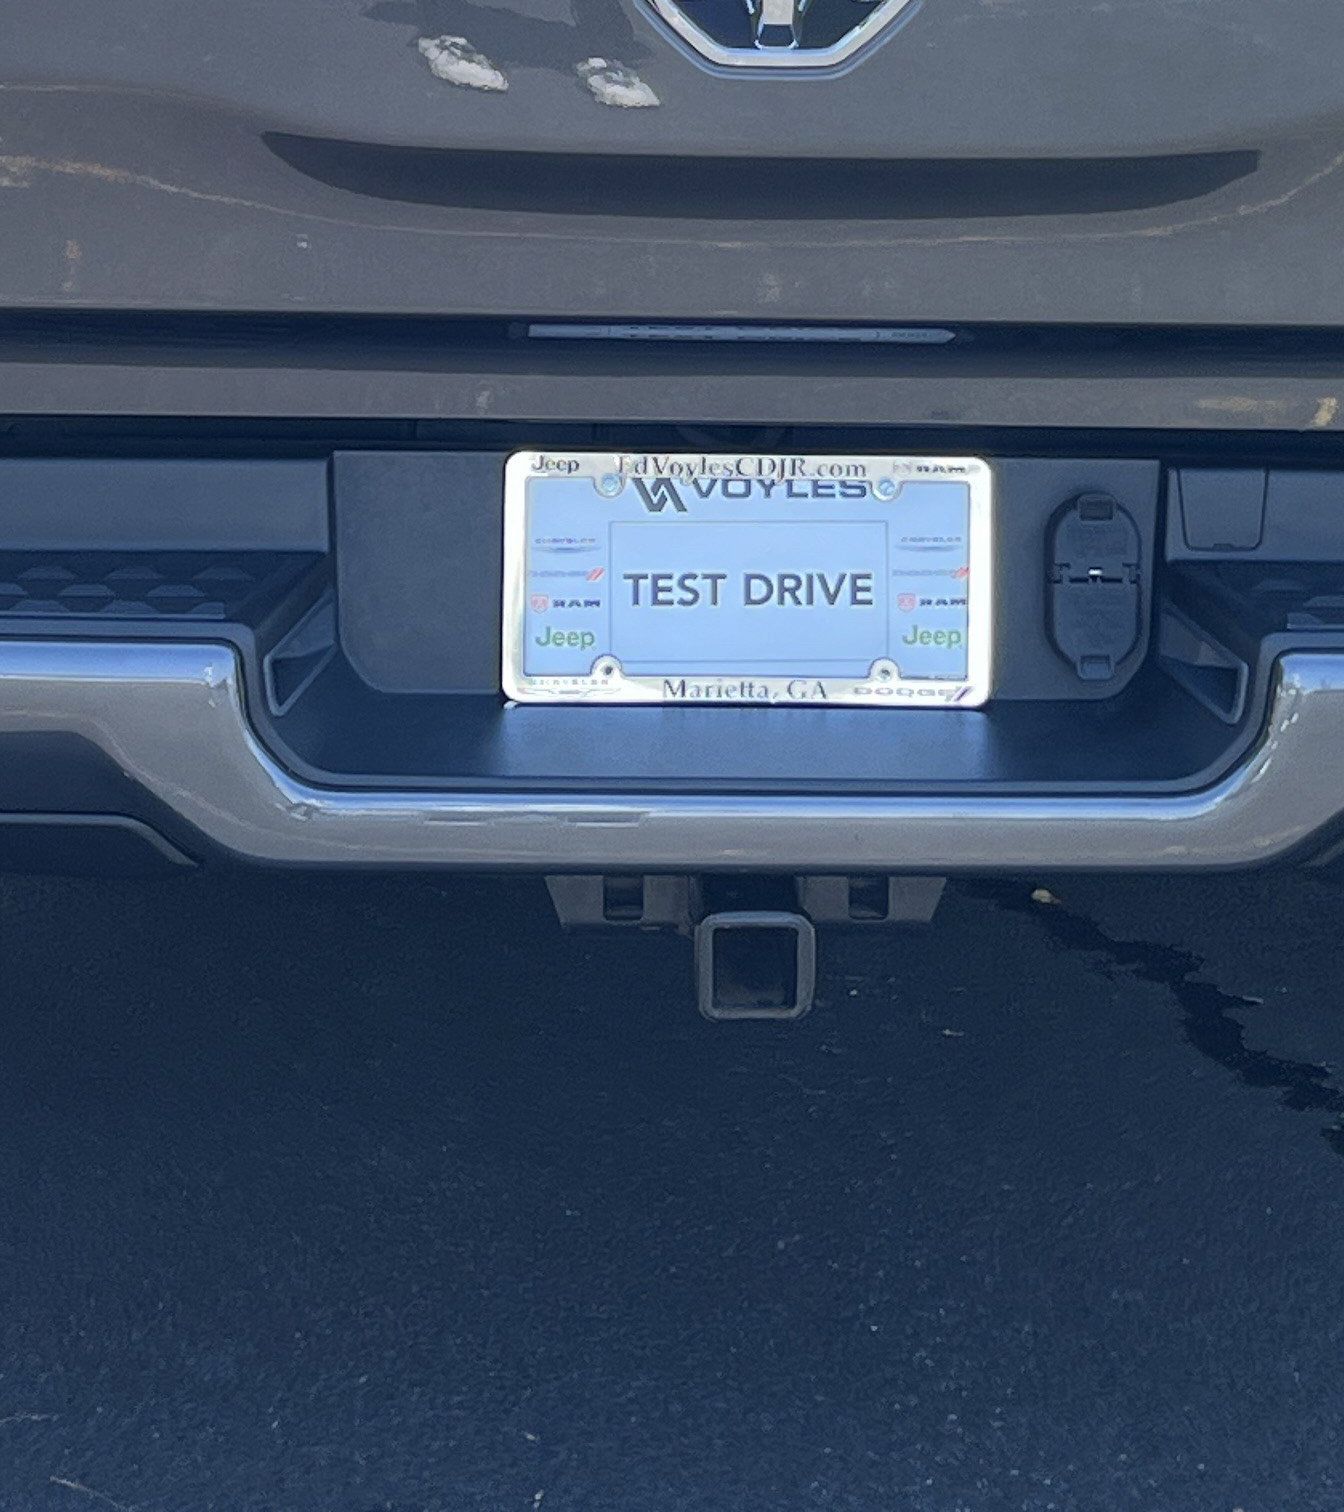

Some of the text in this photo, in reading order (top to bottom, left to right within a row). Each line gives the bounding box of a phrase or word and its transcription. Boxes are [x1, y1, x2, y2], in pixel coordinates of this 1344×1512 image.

[530, 455, 580, 474] Jeep
[692, 477, 868, 499] VOYLES
[622, 572, 874, 607] TEST DRIVE
[535, 625, 596, 650] Jeep
[902, 624, 962, 648] Jeep
[663, 678, 828, 700] Marietta, GA
